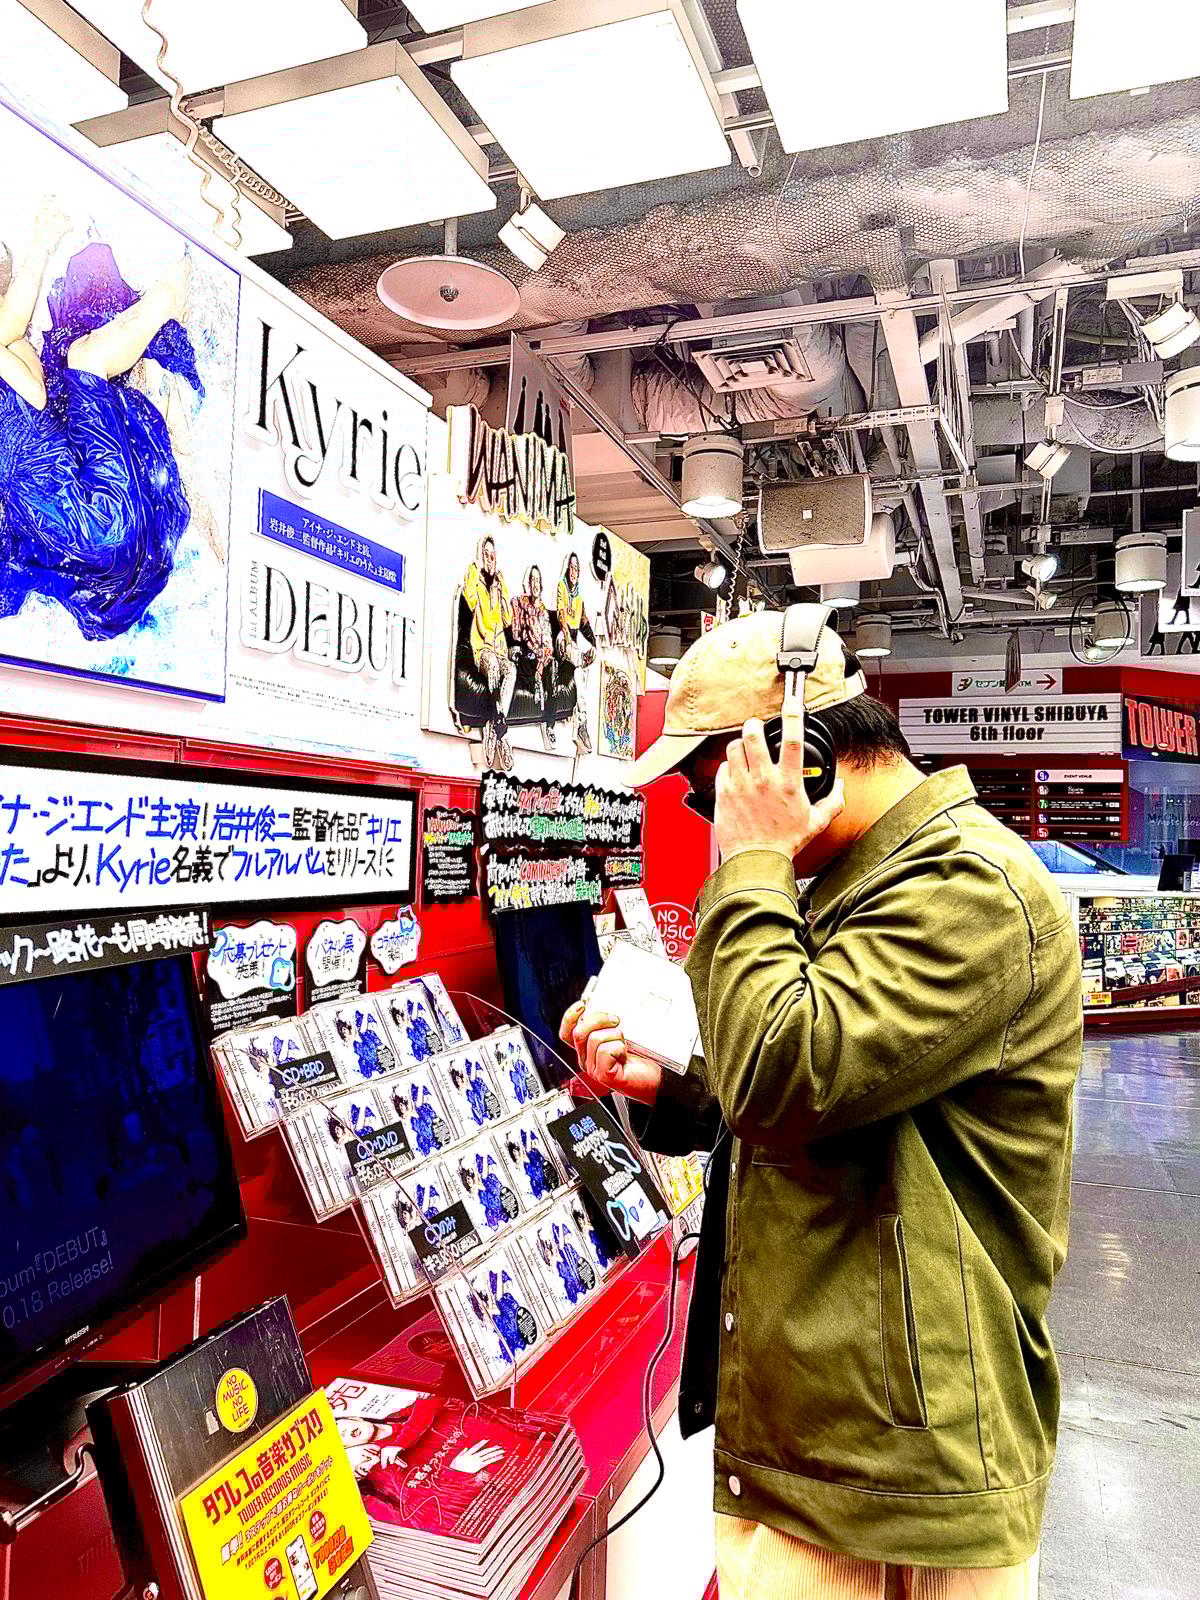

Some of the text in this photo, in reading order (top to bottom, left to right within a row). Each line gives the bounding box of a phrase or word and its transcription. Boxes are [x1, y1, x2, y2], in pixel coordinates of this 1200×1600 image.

[256, 318, 422, 511] Kyrie
[465, 404, 575, 534] WANIMA
[262, 564, 416, 680] DEBUT
[923, 705, 1109, 724] TOWER VINYL SHIBUYA
[1125, 698, 1198, 756] TOWER
[970, 726, 1044, 741] 6th floor
[657, 910, 679, 923] NO
[658, 924, 693, 940] USIC
[282, 1060, 325, 1085] CD+BRD
[357, 1131, 398, 1159] CD+DVD
[48, 1250, 114, 1304] Release!
[226, 1375, 237, 1388] NO
[232, 1396, 243, 1409] NO
[232, 1403, 250, 1422] LIFE
[202, 1408, 324, 1525] タワレコの音楽サブスク
[237, 1453, 313, 1525] TOWER RECORDS MUSIC
